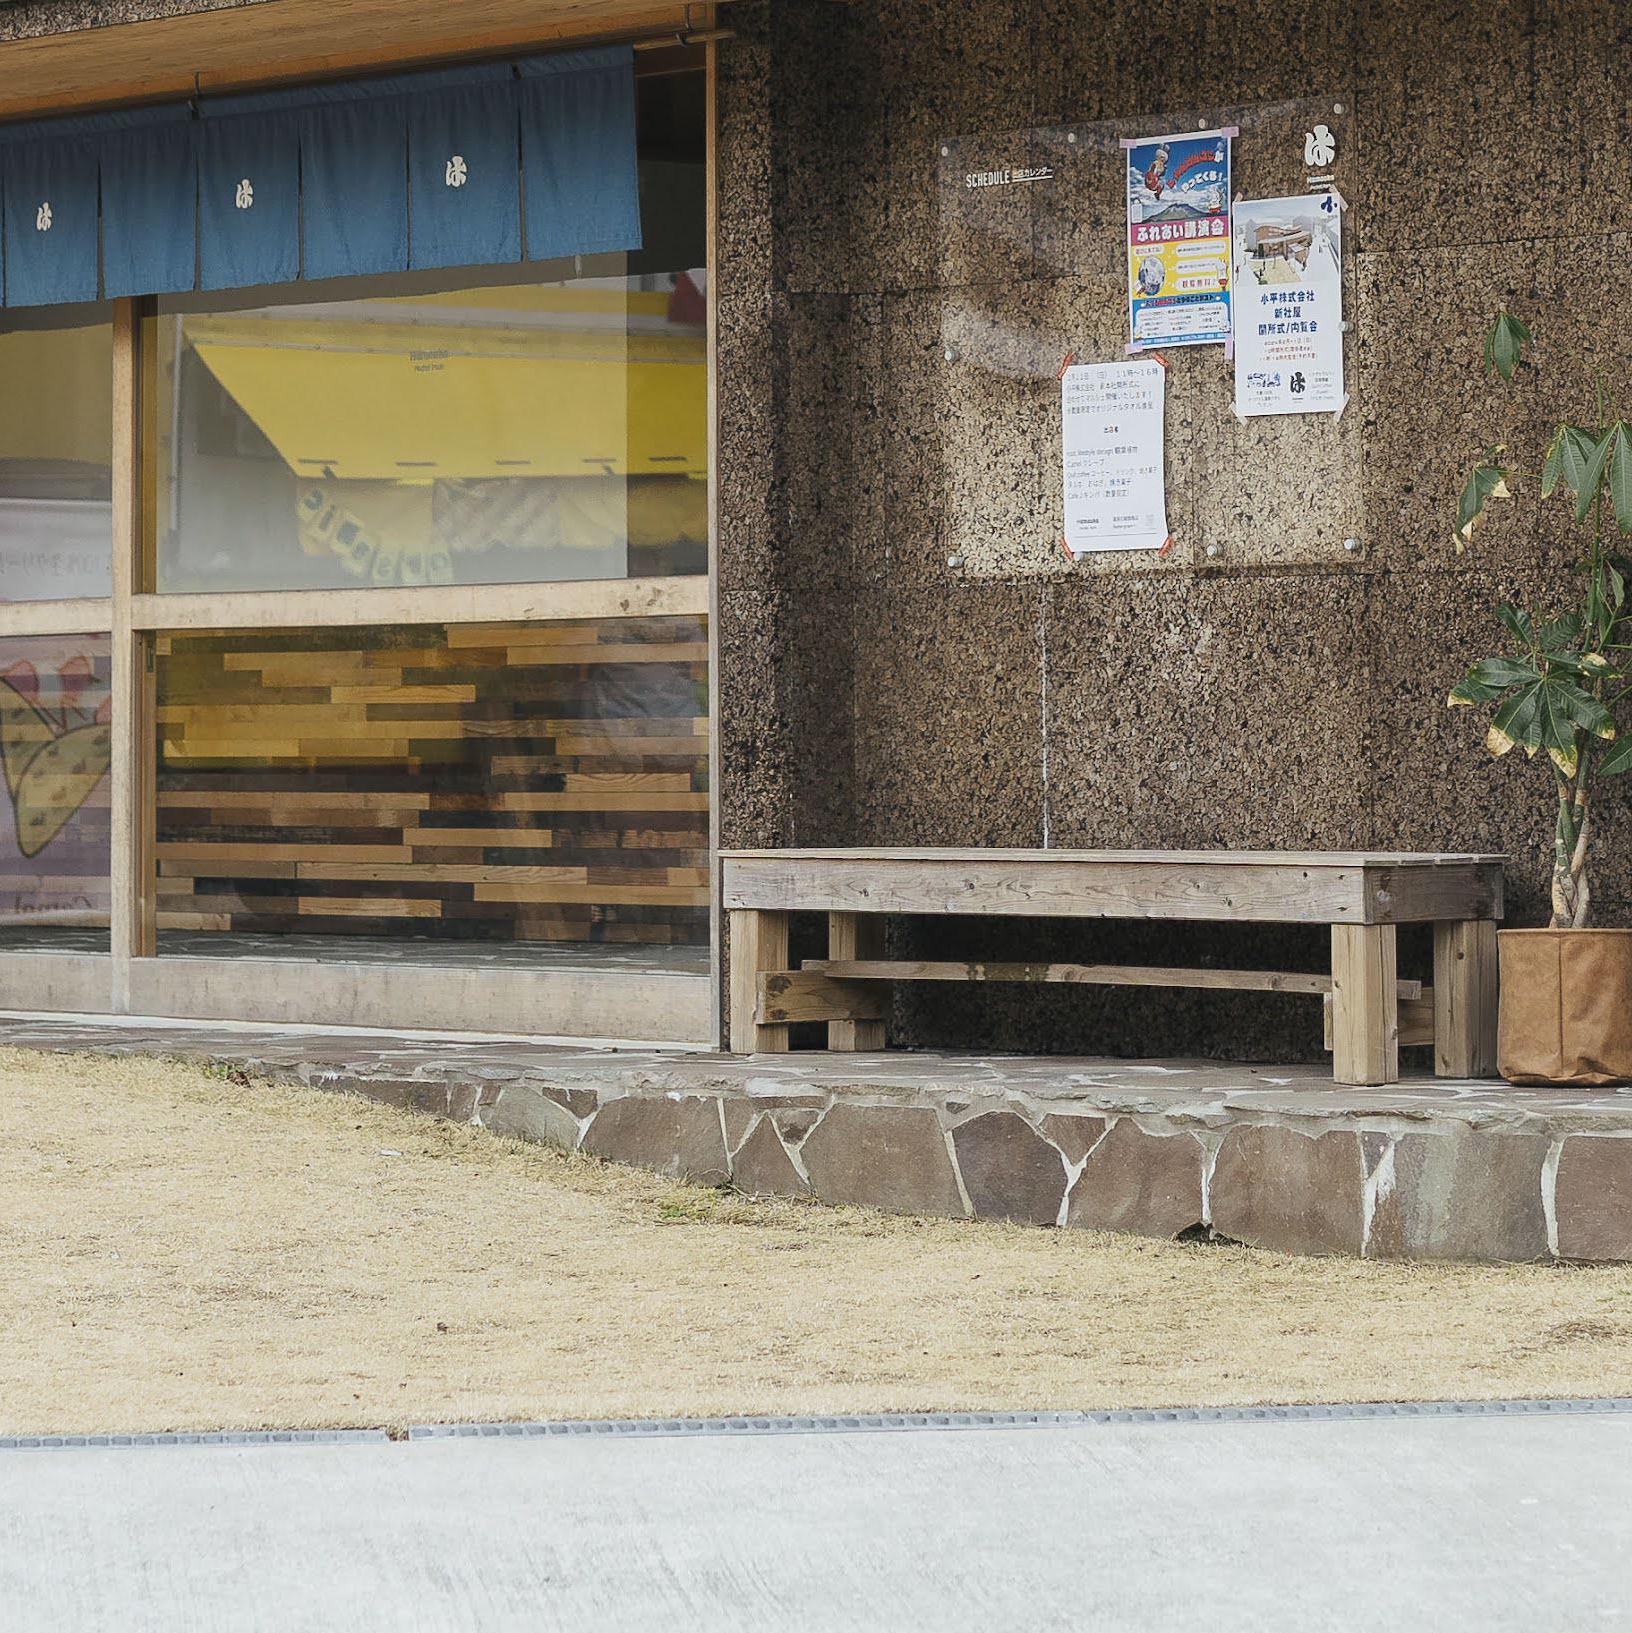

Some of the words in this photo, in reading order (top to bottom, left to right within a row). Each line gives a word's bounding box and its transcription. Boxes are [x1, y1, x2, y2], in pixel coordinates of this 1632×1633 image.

[966, 170, 1010, 188] SCHEDULE
[1260, 290, 1315, 305] 小平株式会社
[1274, 306, 1301, 319] 新社屋
